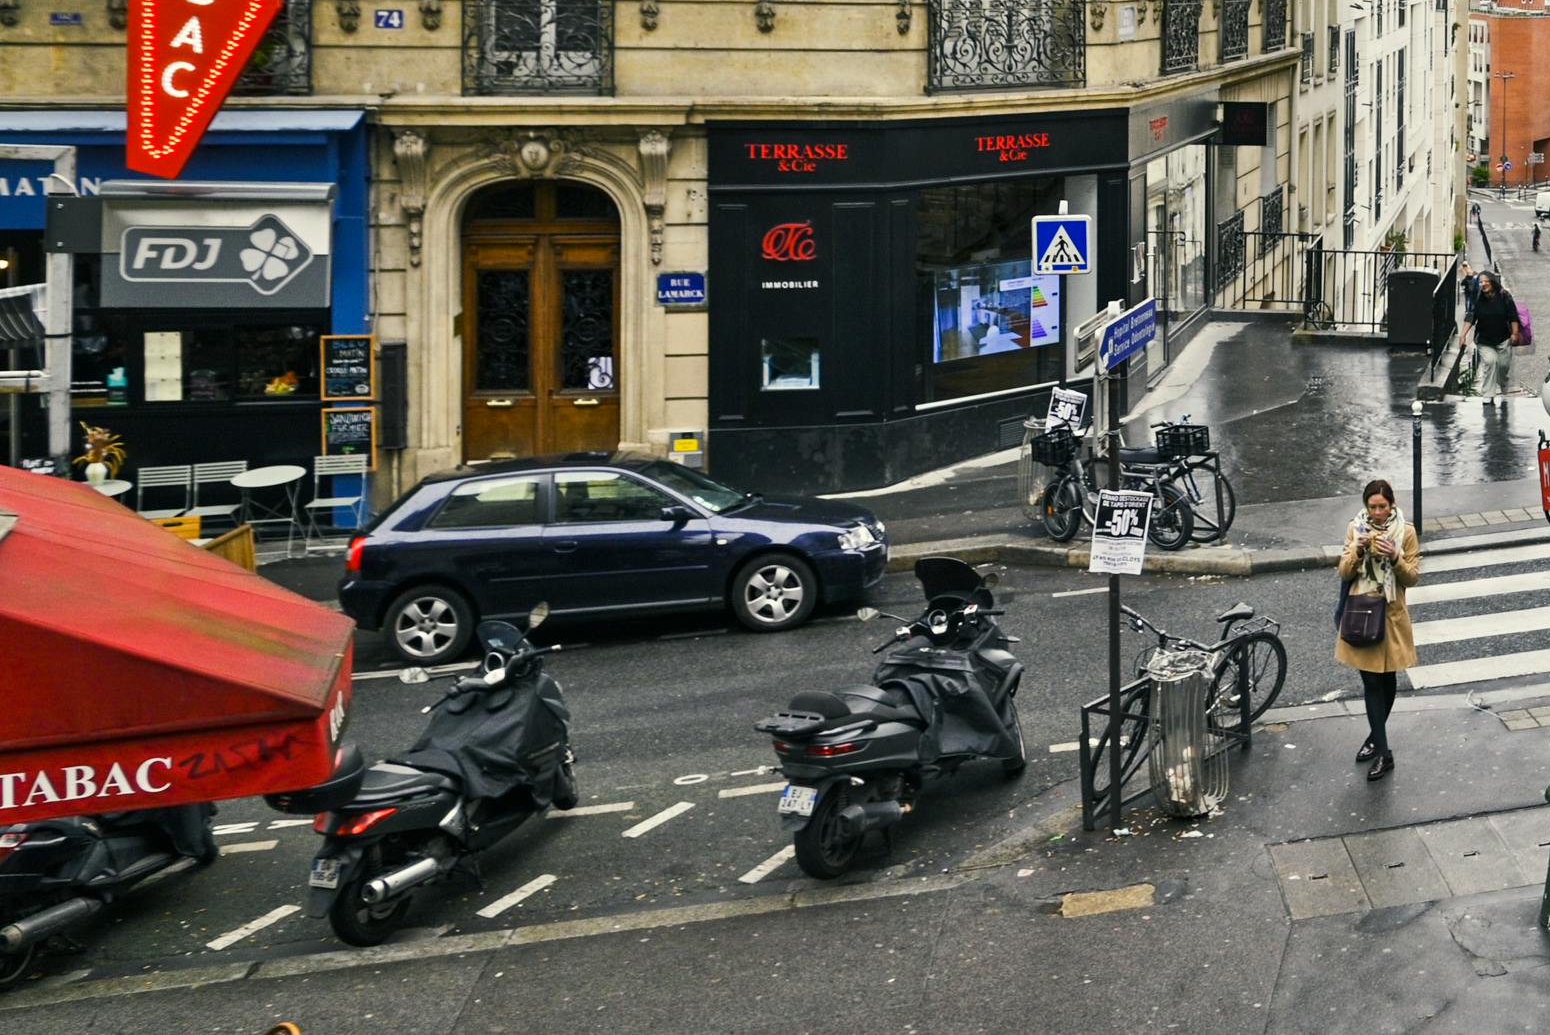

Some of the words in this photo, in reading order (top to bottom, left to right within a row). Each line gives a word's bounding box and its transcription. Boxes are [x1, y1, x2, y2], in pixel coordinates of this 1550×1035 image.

[377, 11, 400, 27] 74
[976, 133, 1050, 152] TERRASSE
[744, 144, 848, 160] TERRASSE
[0, 177, 101, 196] ATN
[132, 238, 222, 270] FDJ
[670, 278, 690, 287] RUE
[762, 280, 818, 289] IMMOBILIER
[658, 288, 704, 299] LAMARCK
[1105, 508, 1139, 536] -50%
[0, 757, 173, 809] TABAC
